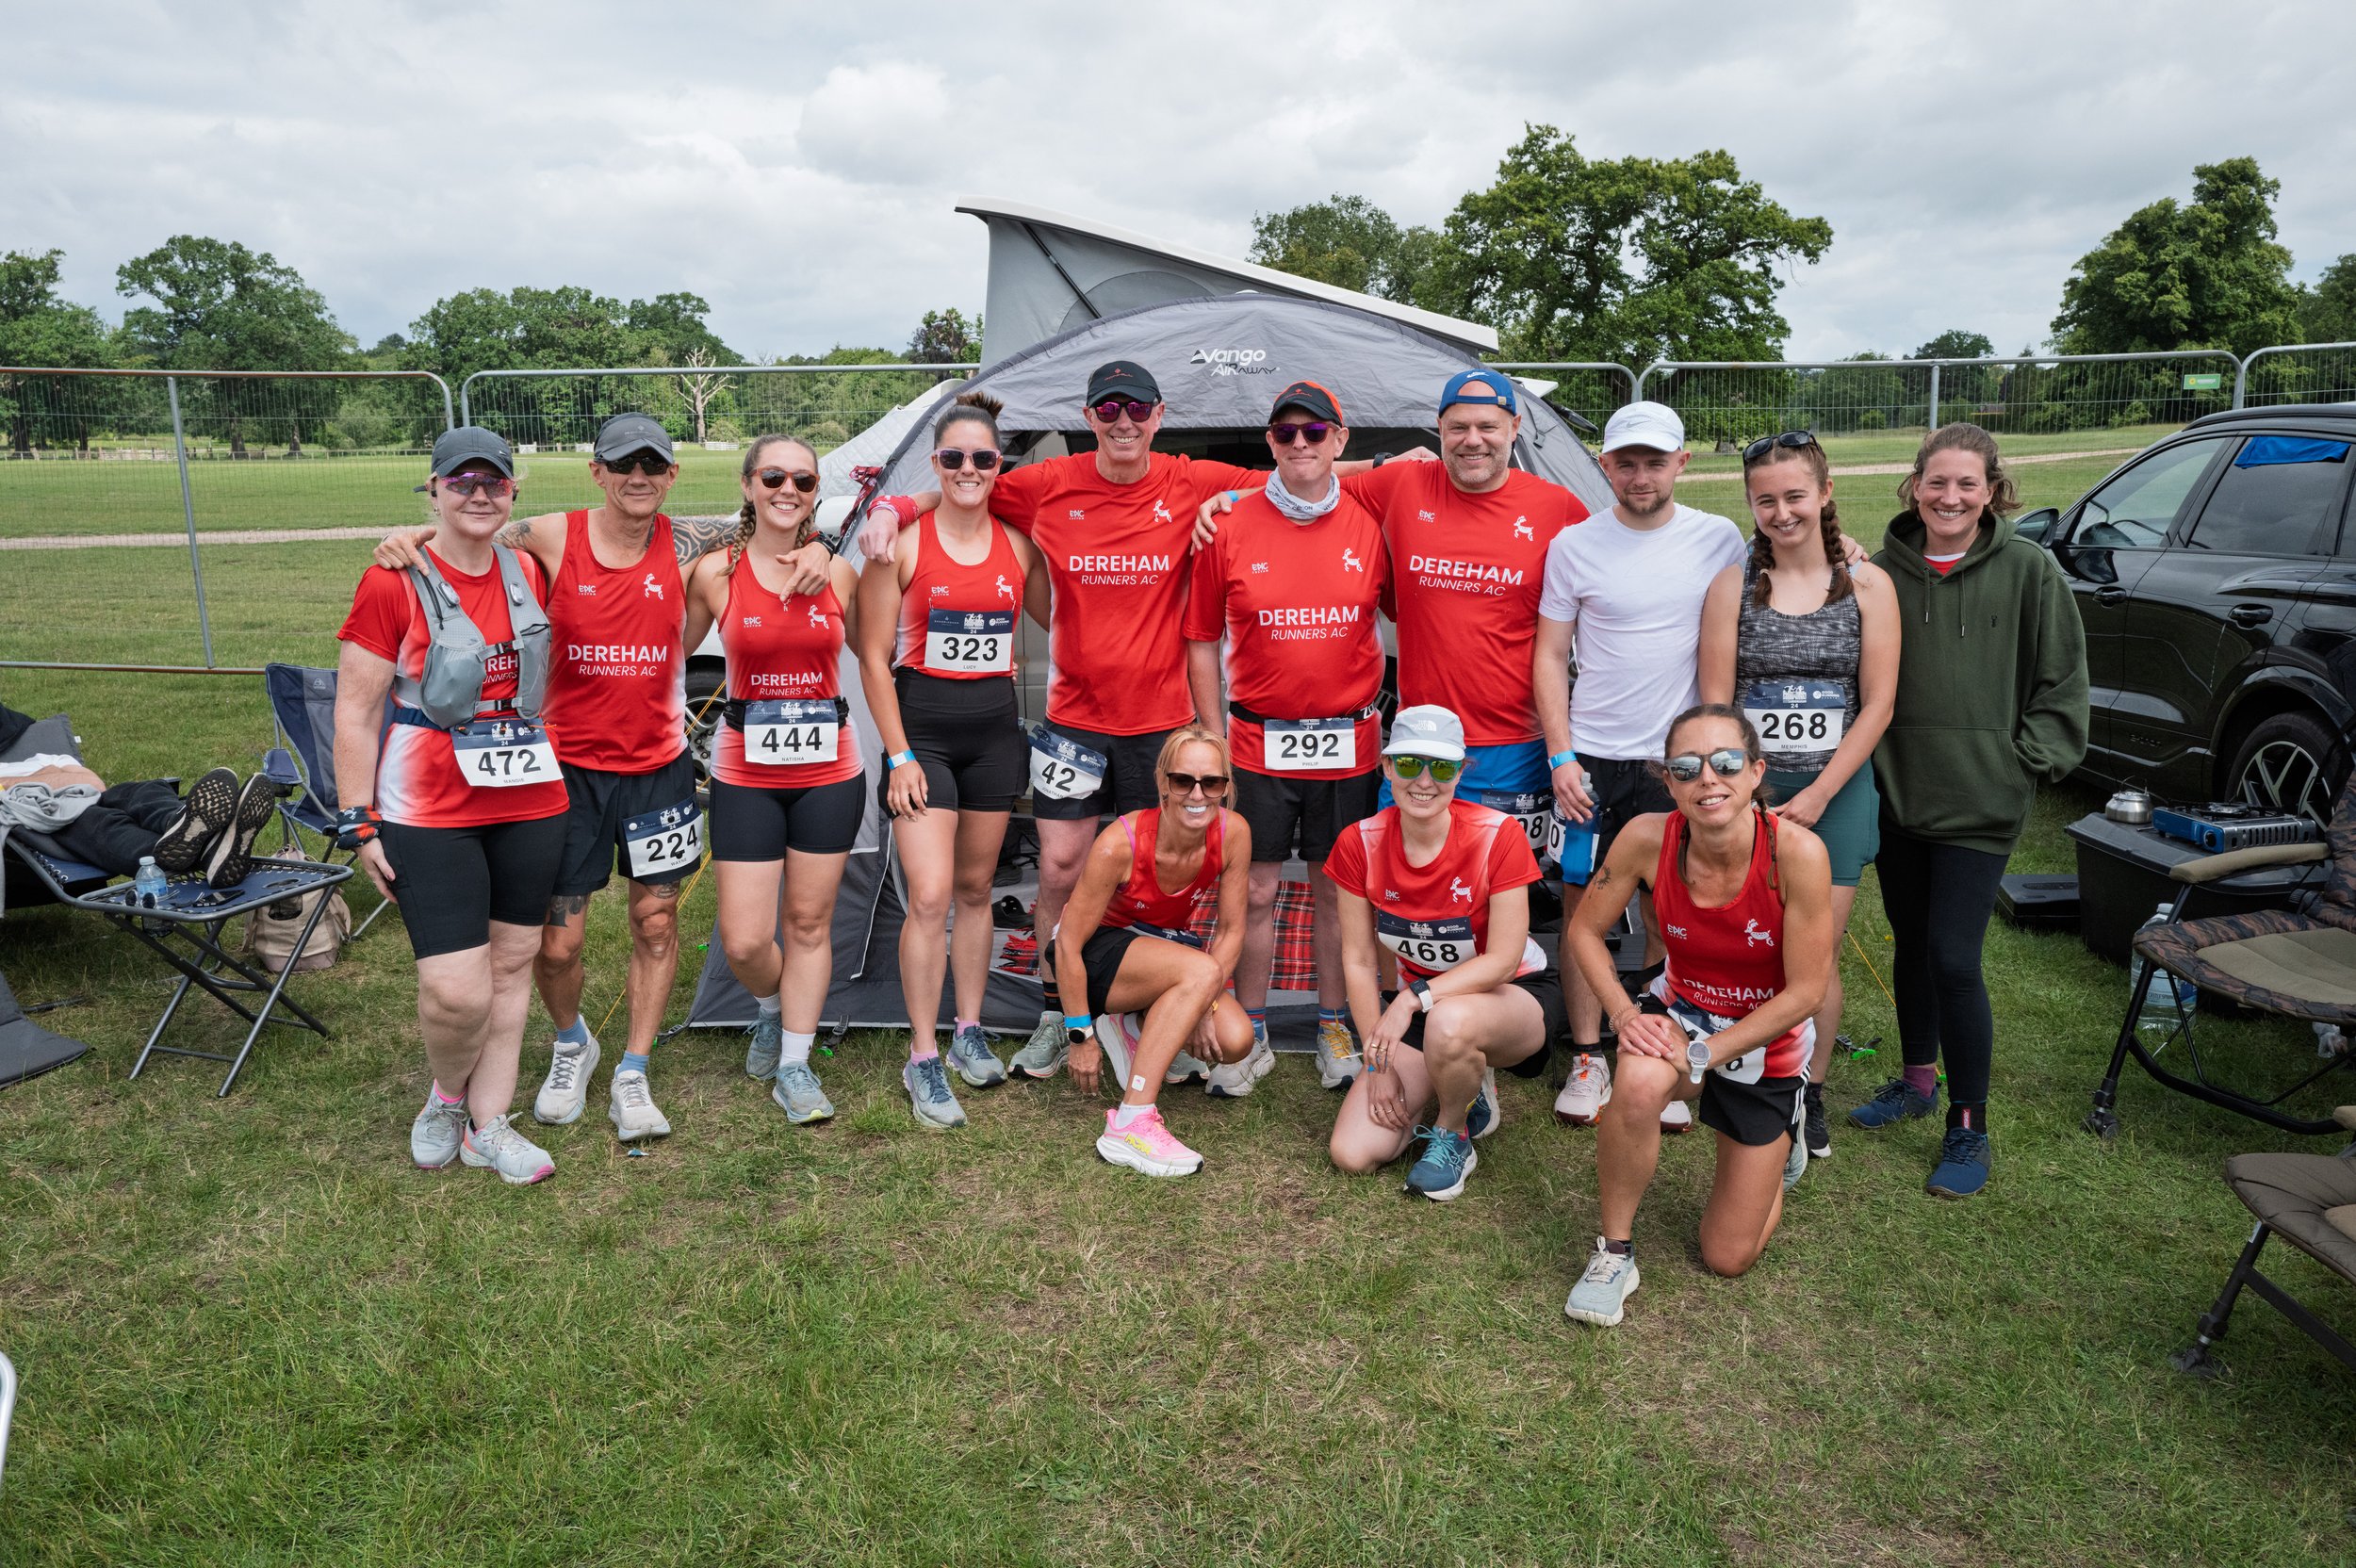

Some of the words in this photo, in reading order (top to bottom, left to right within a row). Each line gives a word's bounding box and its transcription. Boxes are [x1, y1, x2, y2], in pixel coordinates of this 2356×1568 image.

[1199, 349, 1266, 366] Vango
[1069, 555, 1170, 572] DEREHAM
[1409, 555, 1523, 585] DEREHAM
[1081, 575, 1137, 585] RUNNERS
[1139, 575, 1158, 584] AC
[1418, 576, 1481, 593] RUNNERS
[1483, 585, 1506, 596] AC
[1258, 605, 1359, 626] DEREHAM
[1270, 629, 1327, 640] RUNNERS
[1331, 627, 1349, 638] AC
[567, 645, 667, 662] DEREHAM
[942, 636, 998, 662] 323
[482, 671, 517, 684] UNNERS
[579, 664, 637, 676] RUNNERS
[640, 665, 657, 676] AC
[751, 671, 823, 686] DEREHAM
[759, 687, 801, 696] RUNNERS
[803, 686, 816, 694] AC
[1761, 712, 1826, 740] 268
[761, 727, 823, 753] 444
[1281, 733, 1339, 758] 292
[478, 748, 541, 776] 472
[1042, 761, 1076, 792] 42
[646, 824, 697, 862] 224
[1667, 923, 1687, 937] EPIC
[1398, 939, 1460, 963] 468
